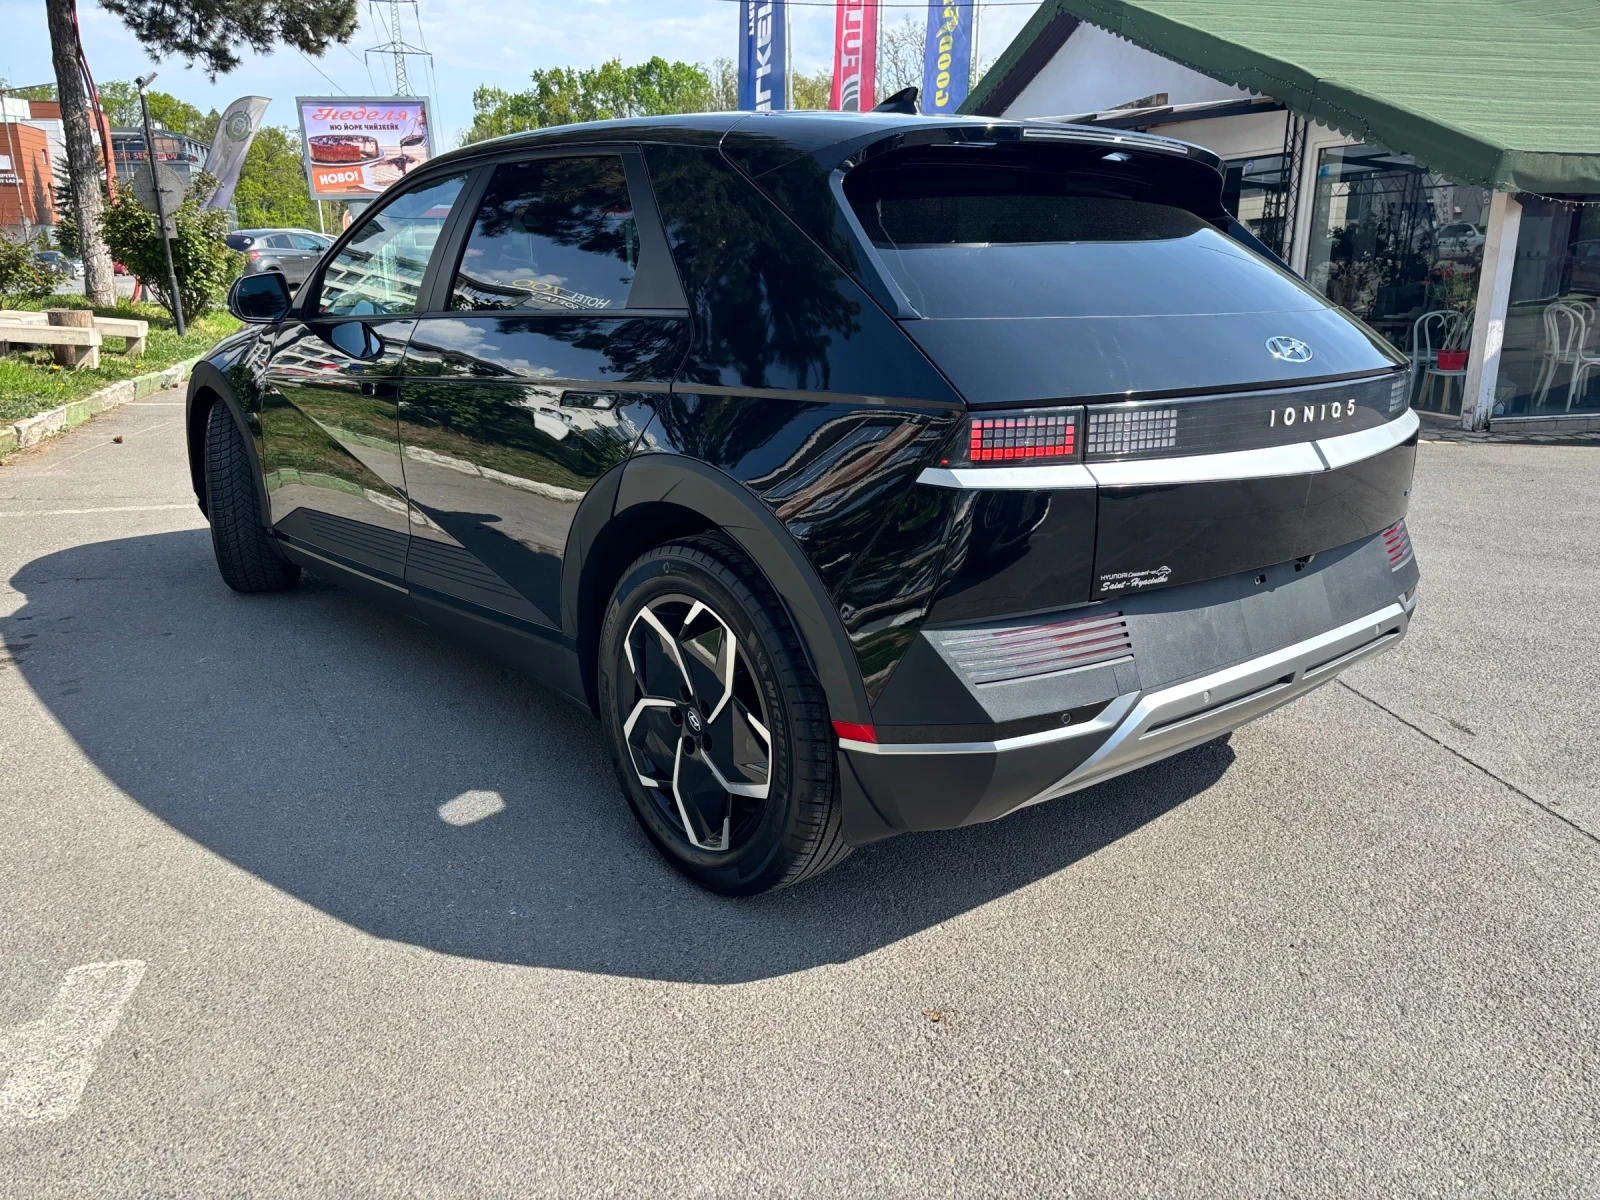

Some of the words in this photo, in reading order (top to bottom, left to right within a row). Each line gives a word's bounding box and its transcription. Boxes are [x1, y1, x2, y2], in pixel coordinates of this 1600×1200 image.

[311, 106, 408, 121] Неделя
[344, 123, 363, 131] ЙОРК
[364, 123, 399, 131] ЧИЙЗКЕЙК
[319, 171, 360, 185] НОВО!
[1100, 572, 1128, 581] HYUNDAI
